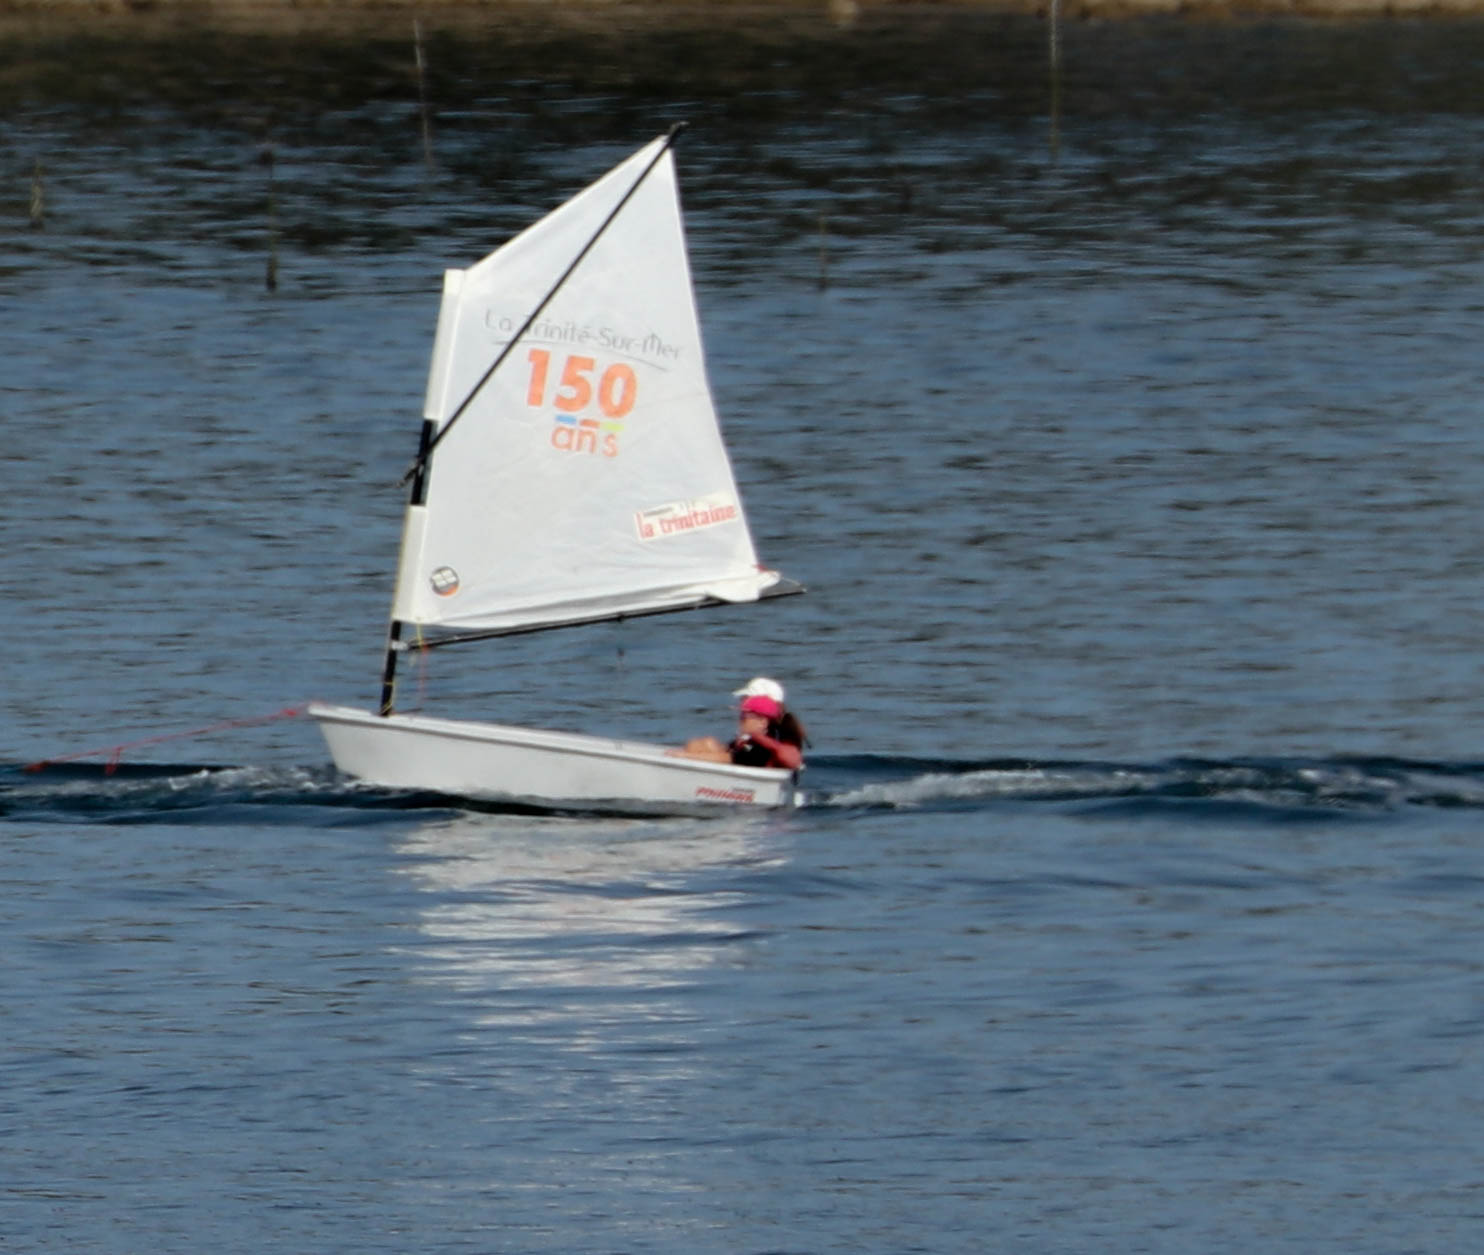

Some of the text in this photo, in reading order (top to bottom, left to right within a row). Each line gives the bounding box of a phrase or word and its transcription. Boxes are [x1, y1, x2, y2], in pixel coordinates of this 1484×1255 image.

[484, 309, 513, 333] La
[527, 347, 638, 419] 150
[551, 425, 619, 458] ans
